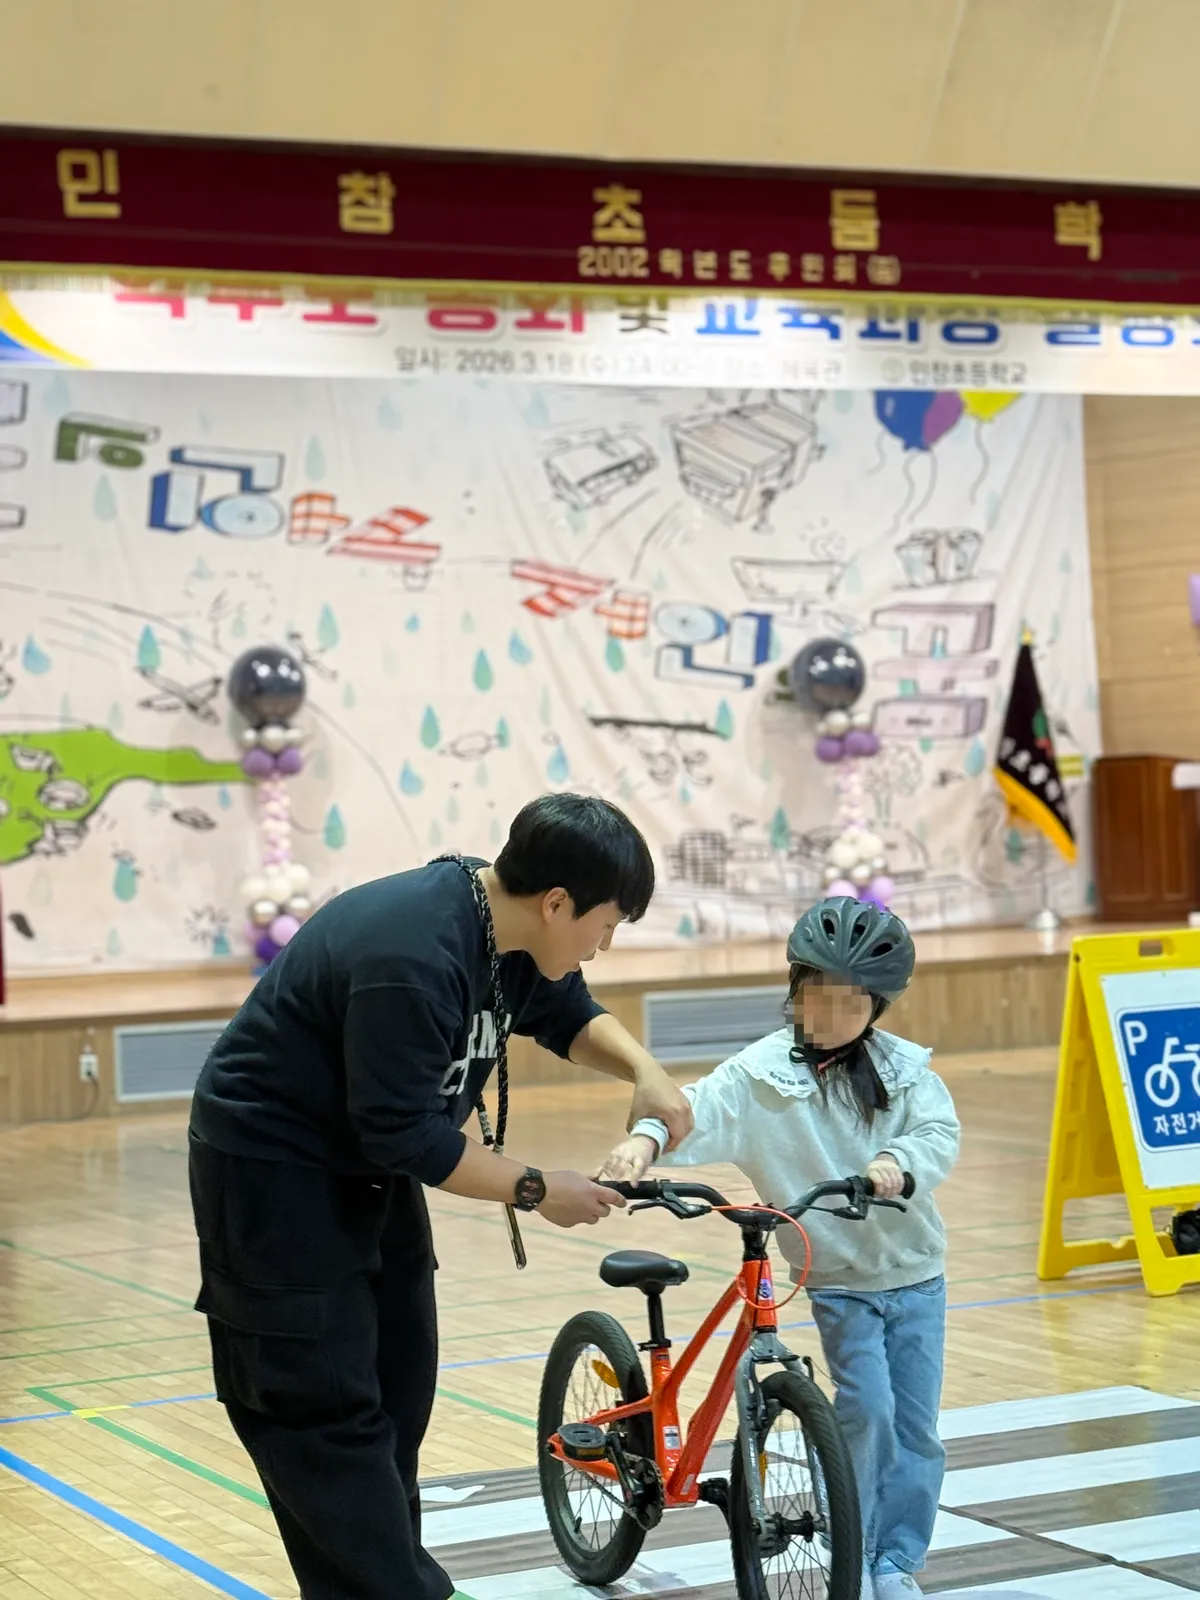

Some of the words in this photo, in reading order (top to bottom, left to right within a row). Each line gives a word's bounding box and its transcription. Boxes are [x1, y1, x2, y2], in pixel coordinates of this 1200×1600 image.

[592, 184, 646, 244] 초
[830, 188, 881, 252] 등
[577, 246, 650, 278] 2002
[1123, 1019, 1148, 1057] P
